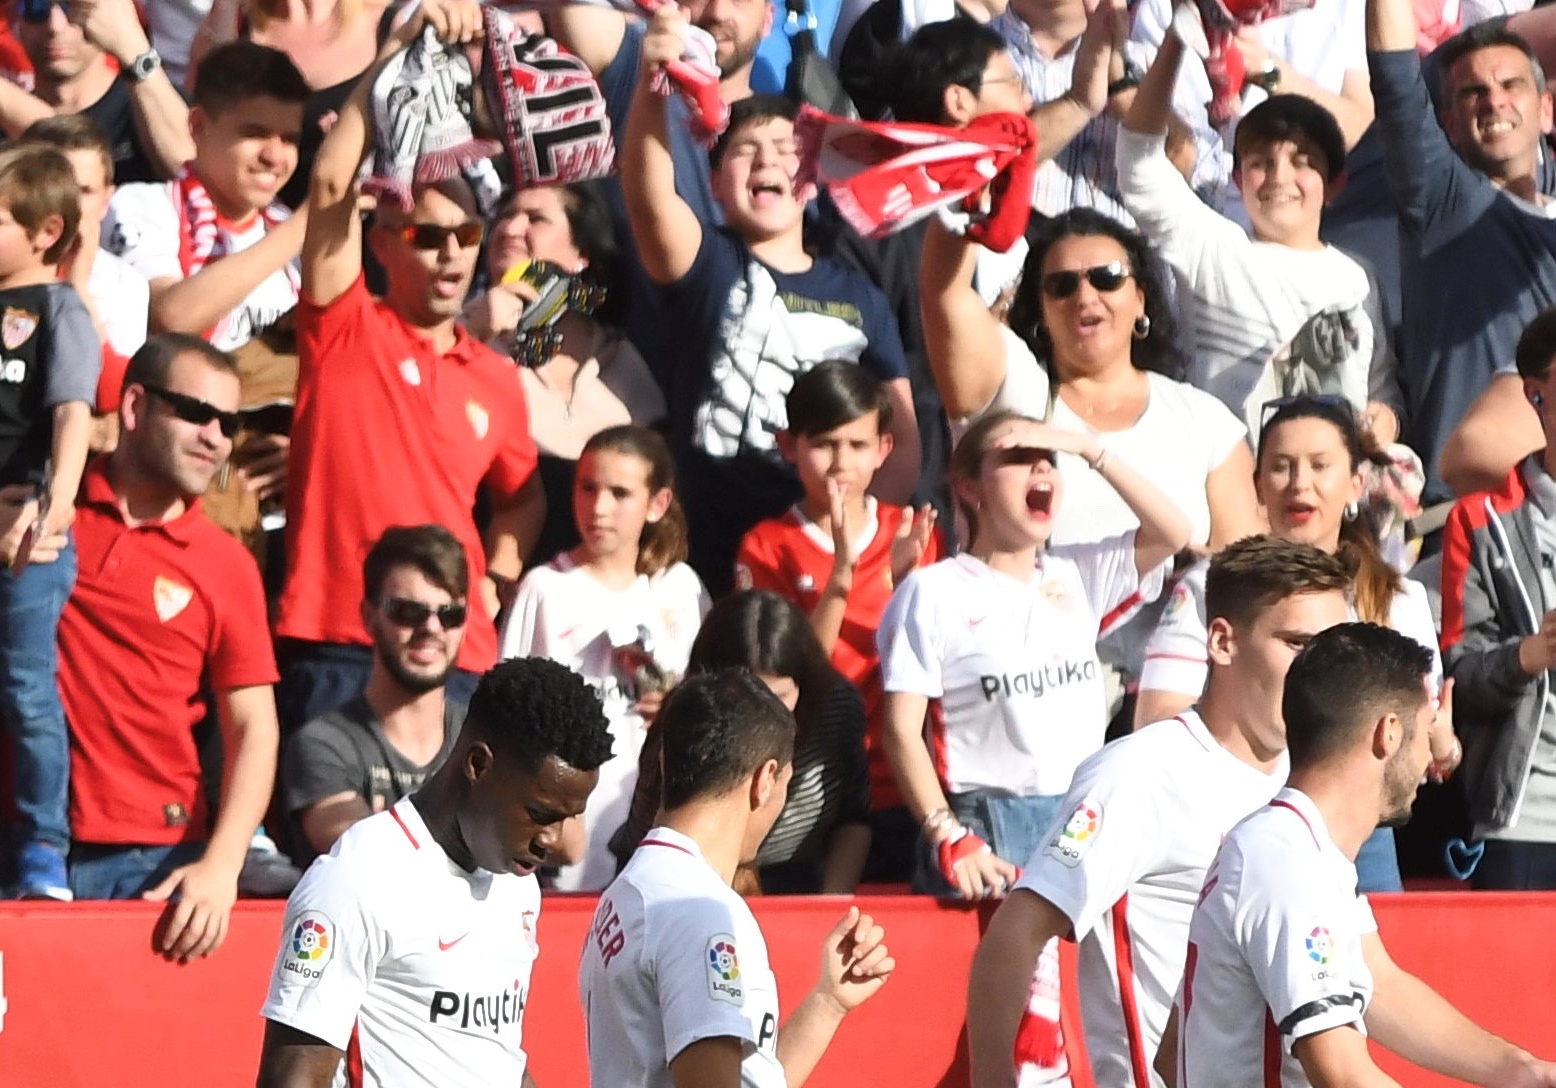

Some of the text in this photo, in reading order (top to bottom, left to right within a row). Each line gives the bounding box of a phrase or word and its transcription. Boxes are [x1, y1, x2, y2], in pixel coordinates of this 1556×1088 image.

[980, 655, 1095, 702] Playtika
[283, 958, 321, 979] LaLiga
[712, 980, 742, 998] LaLiga
